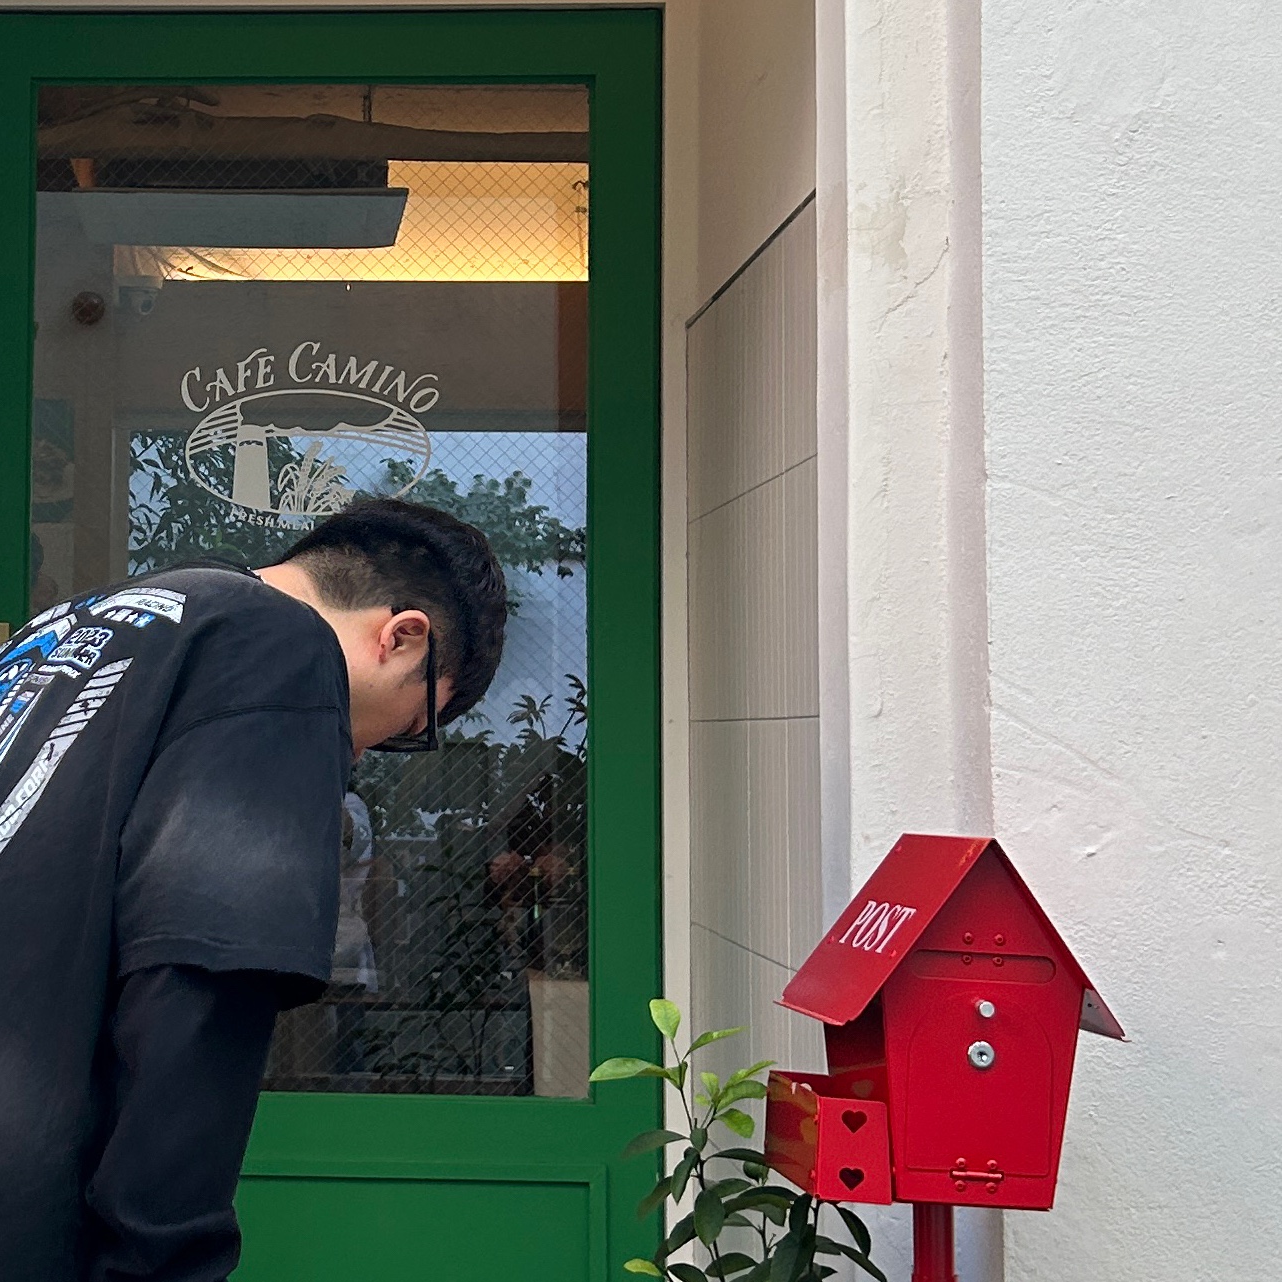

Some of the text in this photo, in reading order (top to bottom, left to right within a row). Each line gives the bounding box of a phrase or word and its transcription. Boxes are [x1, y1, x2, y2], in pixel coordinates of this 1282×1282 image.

[180, 341, 440, 413] CAFE CAMINO
[839, 900, 917, 954] POST
